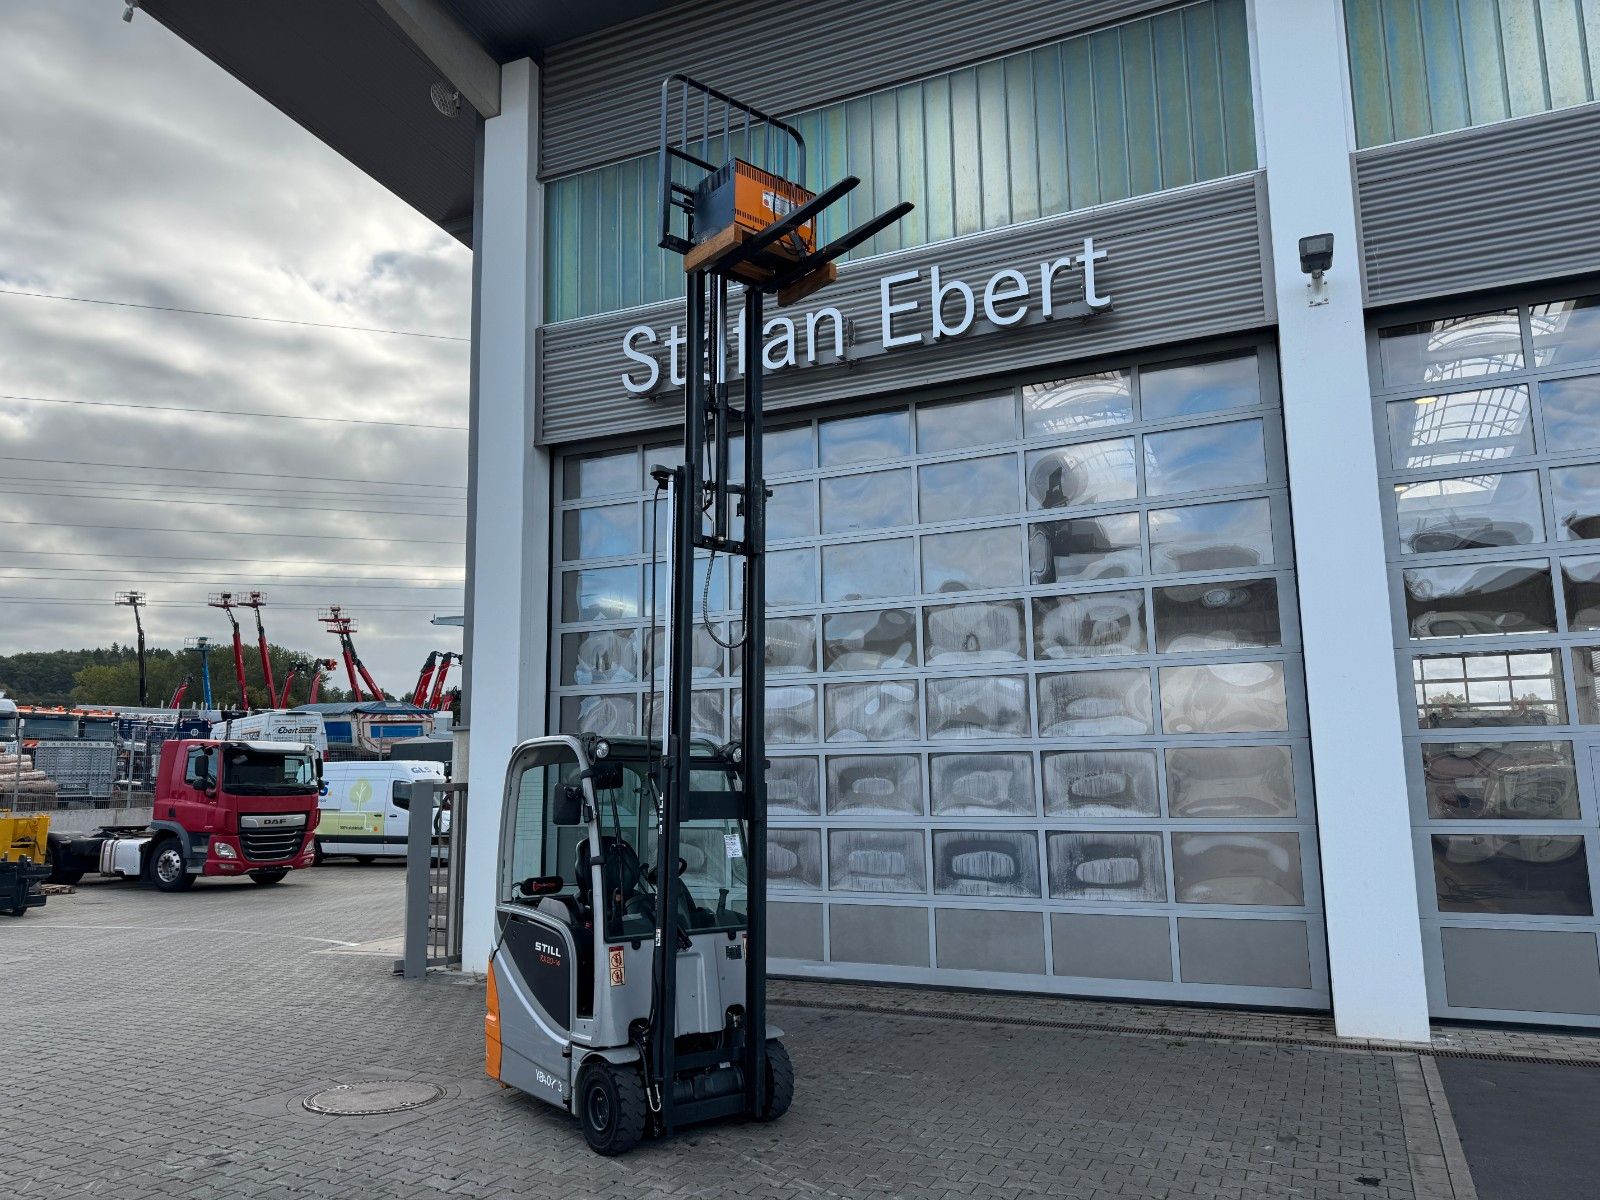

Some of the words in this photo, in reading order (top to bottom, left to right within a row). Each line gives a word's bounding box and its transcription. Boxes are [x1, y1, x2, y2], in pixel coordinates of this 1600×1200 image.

[622, 307, 844, 393] Stfan
[880, 237, 1112, 349] Ebert
[411, 766, 432, 774] GLS
[535, 941, 561, 958] STILL
